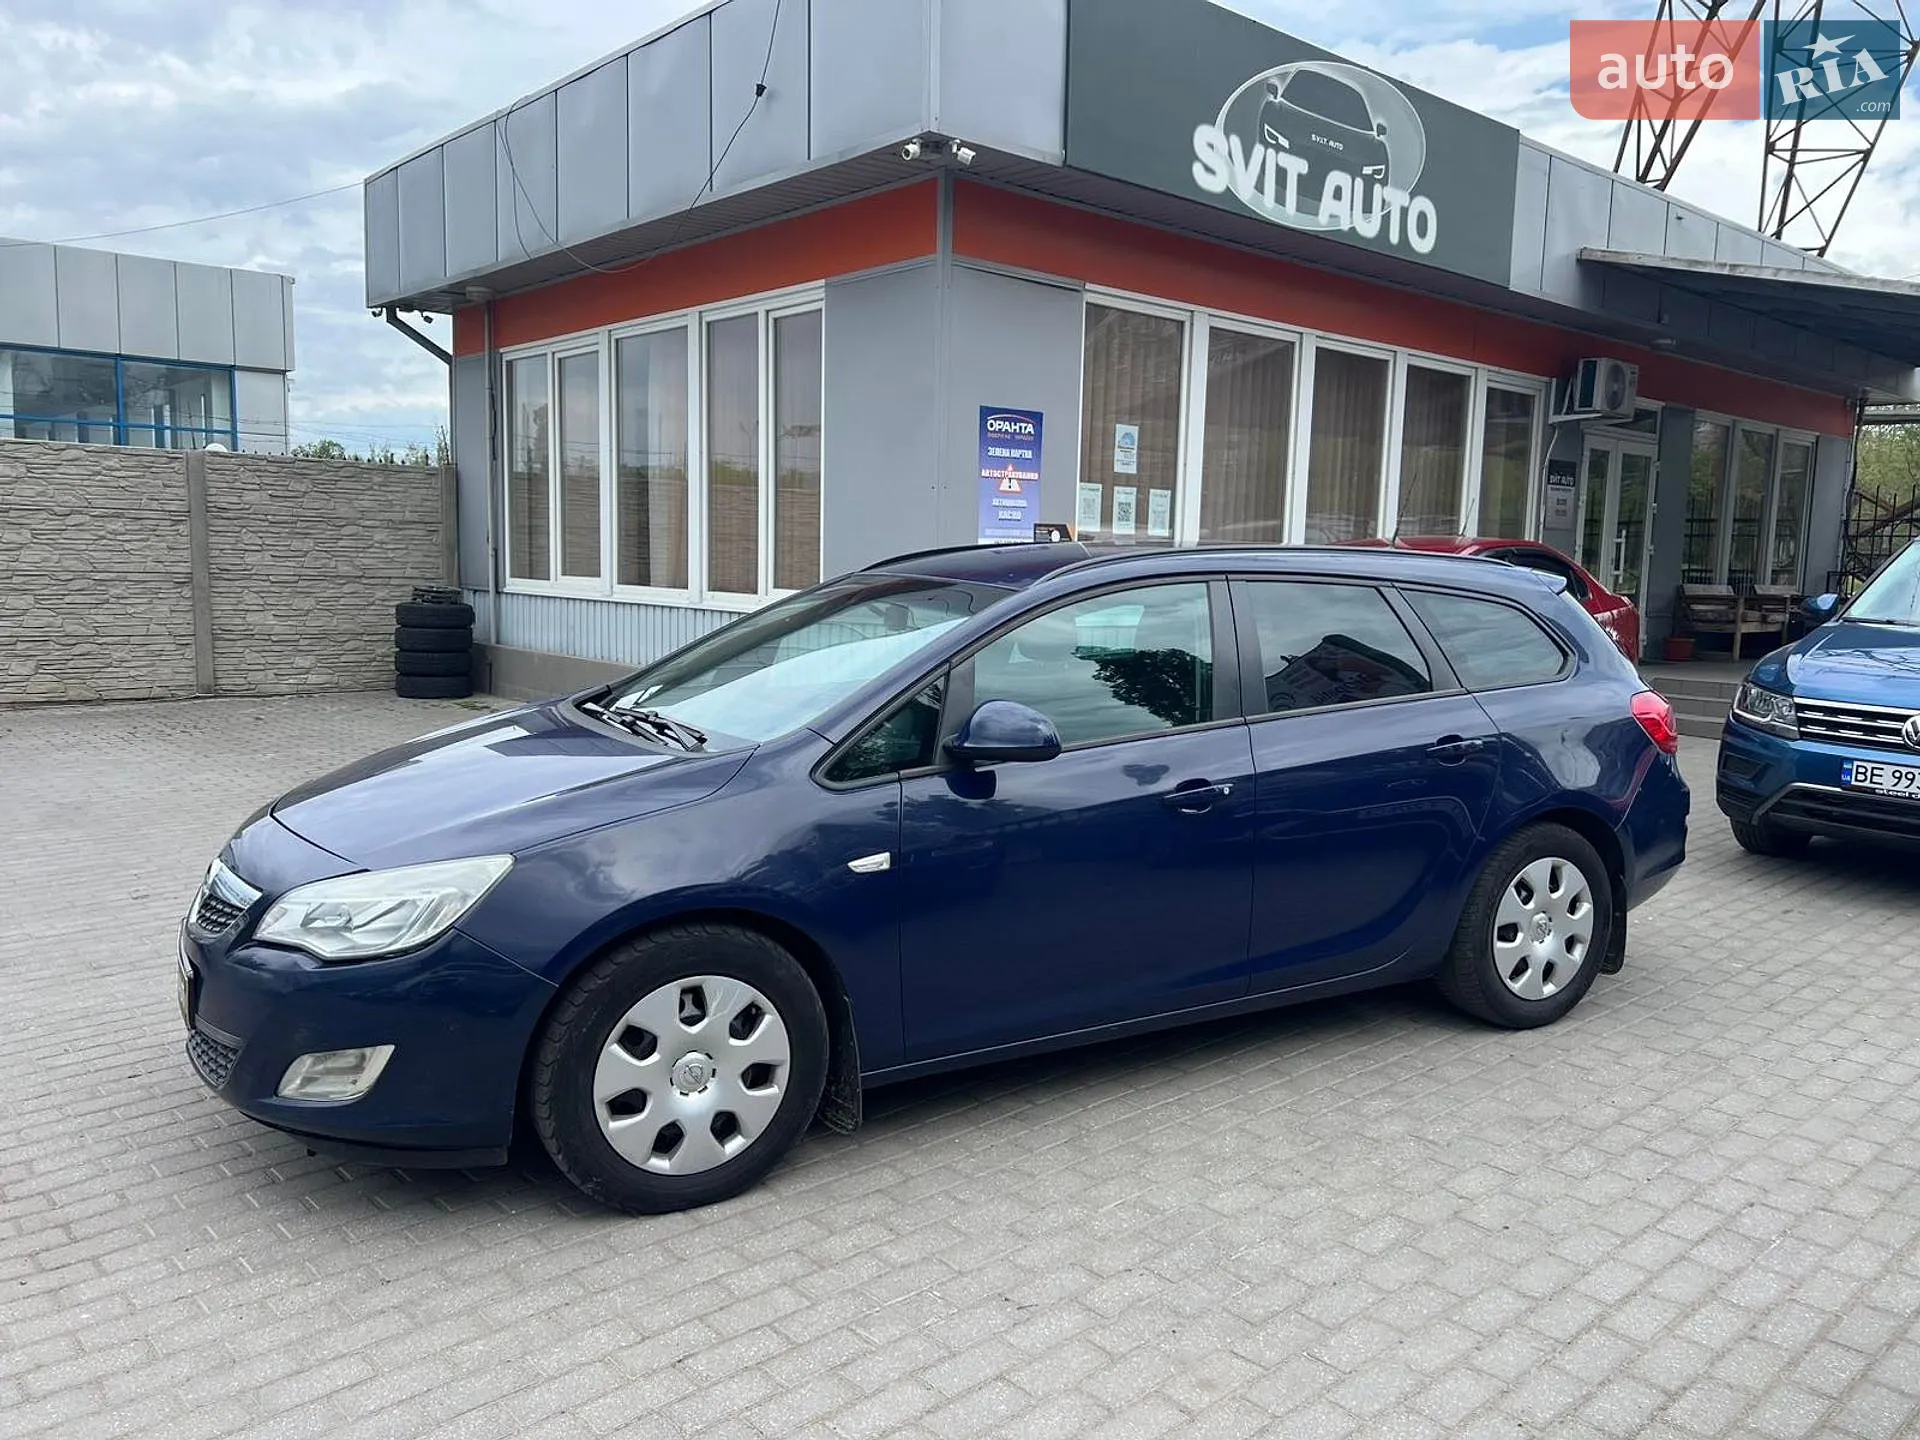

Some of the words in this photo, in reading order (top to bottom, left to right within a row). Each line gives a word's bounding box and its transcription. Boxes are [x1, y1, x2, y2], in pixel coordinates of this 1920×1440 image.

[1192, 123, 1309, 216] SVIT
[1318, 169, 1438, 254] AUTO
[986, 419, 1035, 434] ОРАНТА
[1854, 764, 1884, 786] BE
